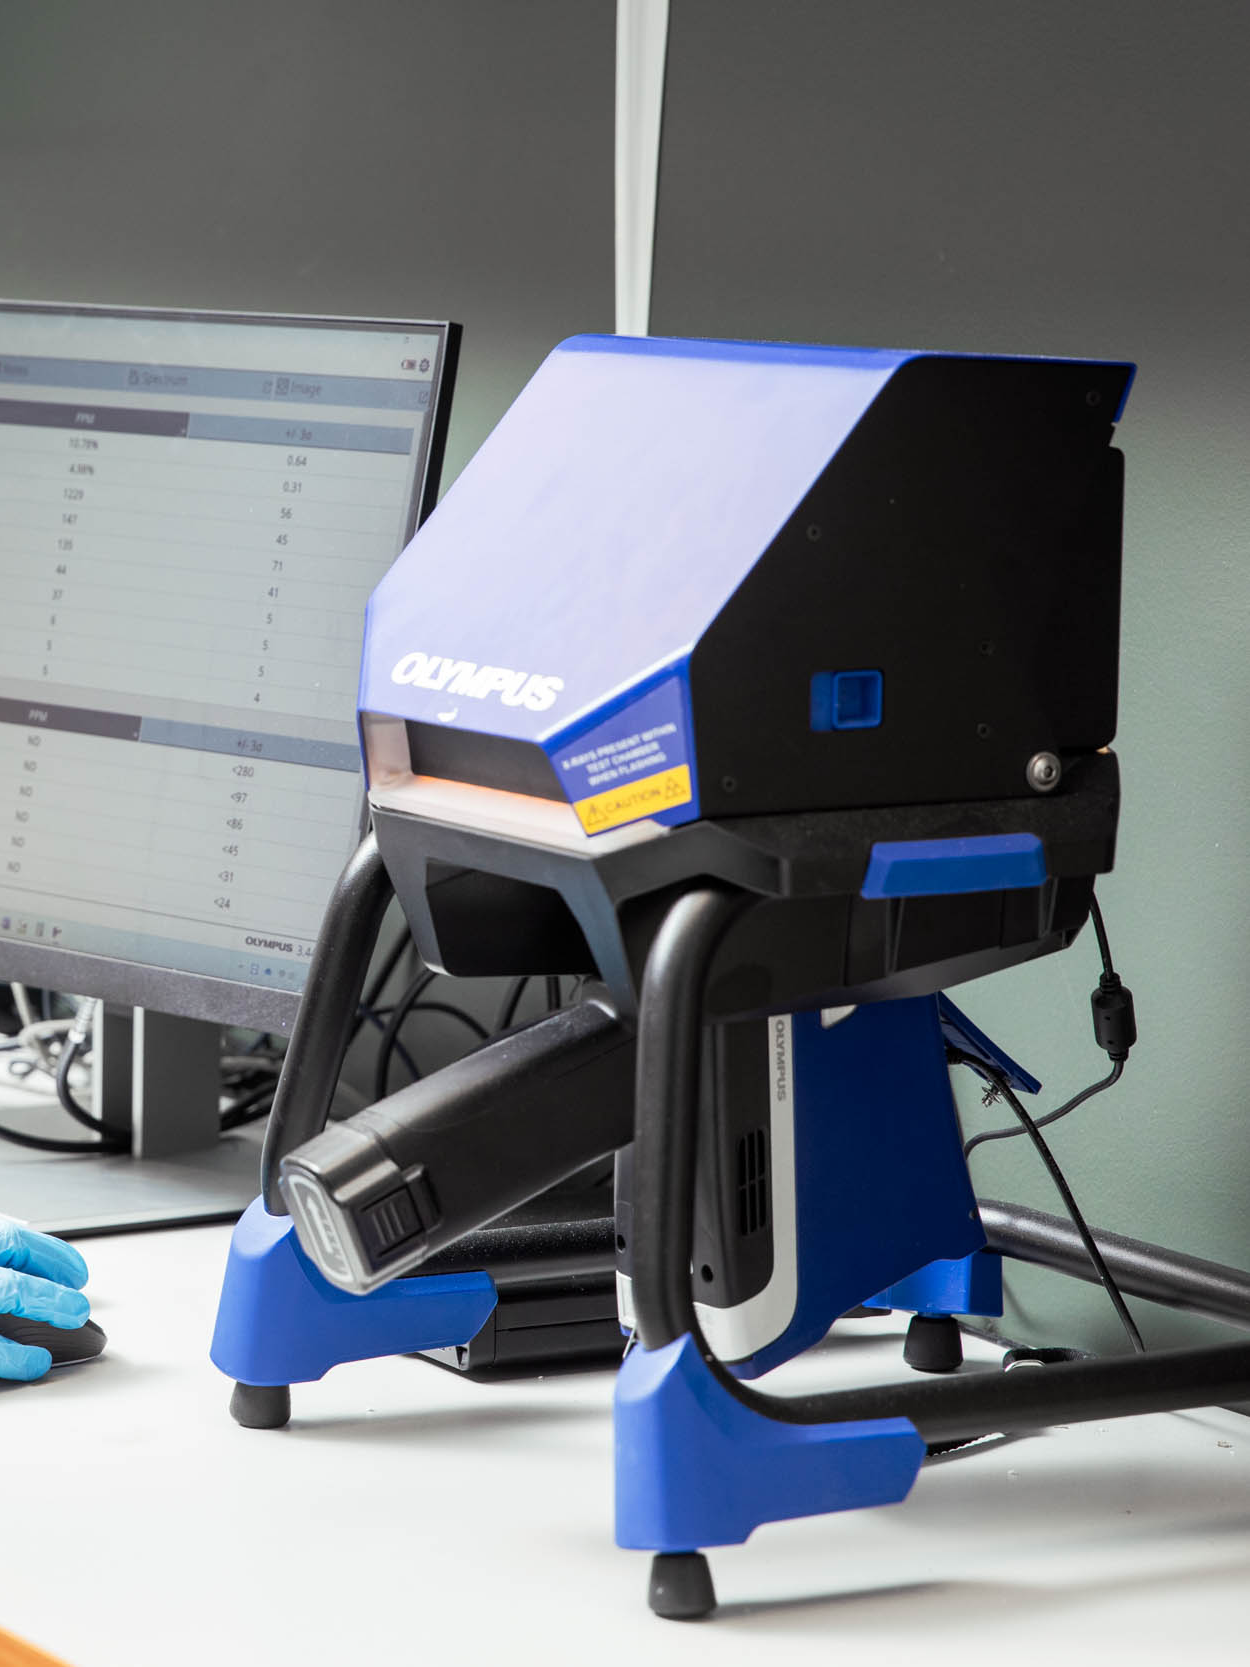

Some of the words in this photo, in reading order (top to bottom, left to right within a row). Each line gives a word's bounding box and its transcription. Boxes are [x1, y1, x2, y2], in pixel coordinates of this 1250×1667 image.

[290, 381, 323, 398] Image
[286, 455, 308, 468] 0.64
[282, 481, 303, 494] 0.31
[280, 507, 293, 519] 56
[275, 534, 289, 546] 45
[271, 559, 284, 572] 71
[267, 586, 279, 598] 41
[266, 612, 273, 625] 5
[262, 639, 269, 652] 5
[258, 665, 265, 678] 5
[390, 651, 565, 712] OLYMPUS
[254, 692, 261, 704] 4
[596, 734, 641, 758] PRESENT
[641, 722, 677, 743] WITHIN
[586, 757, 611, 775] TEST
[610, 740, 661, 766] CHAMBER
[604, 788, 662, 814] CAUTION
[245, 935, 293, 952] OLYMPUS
[775, 1019, 787, 1102] OLYMPUS
